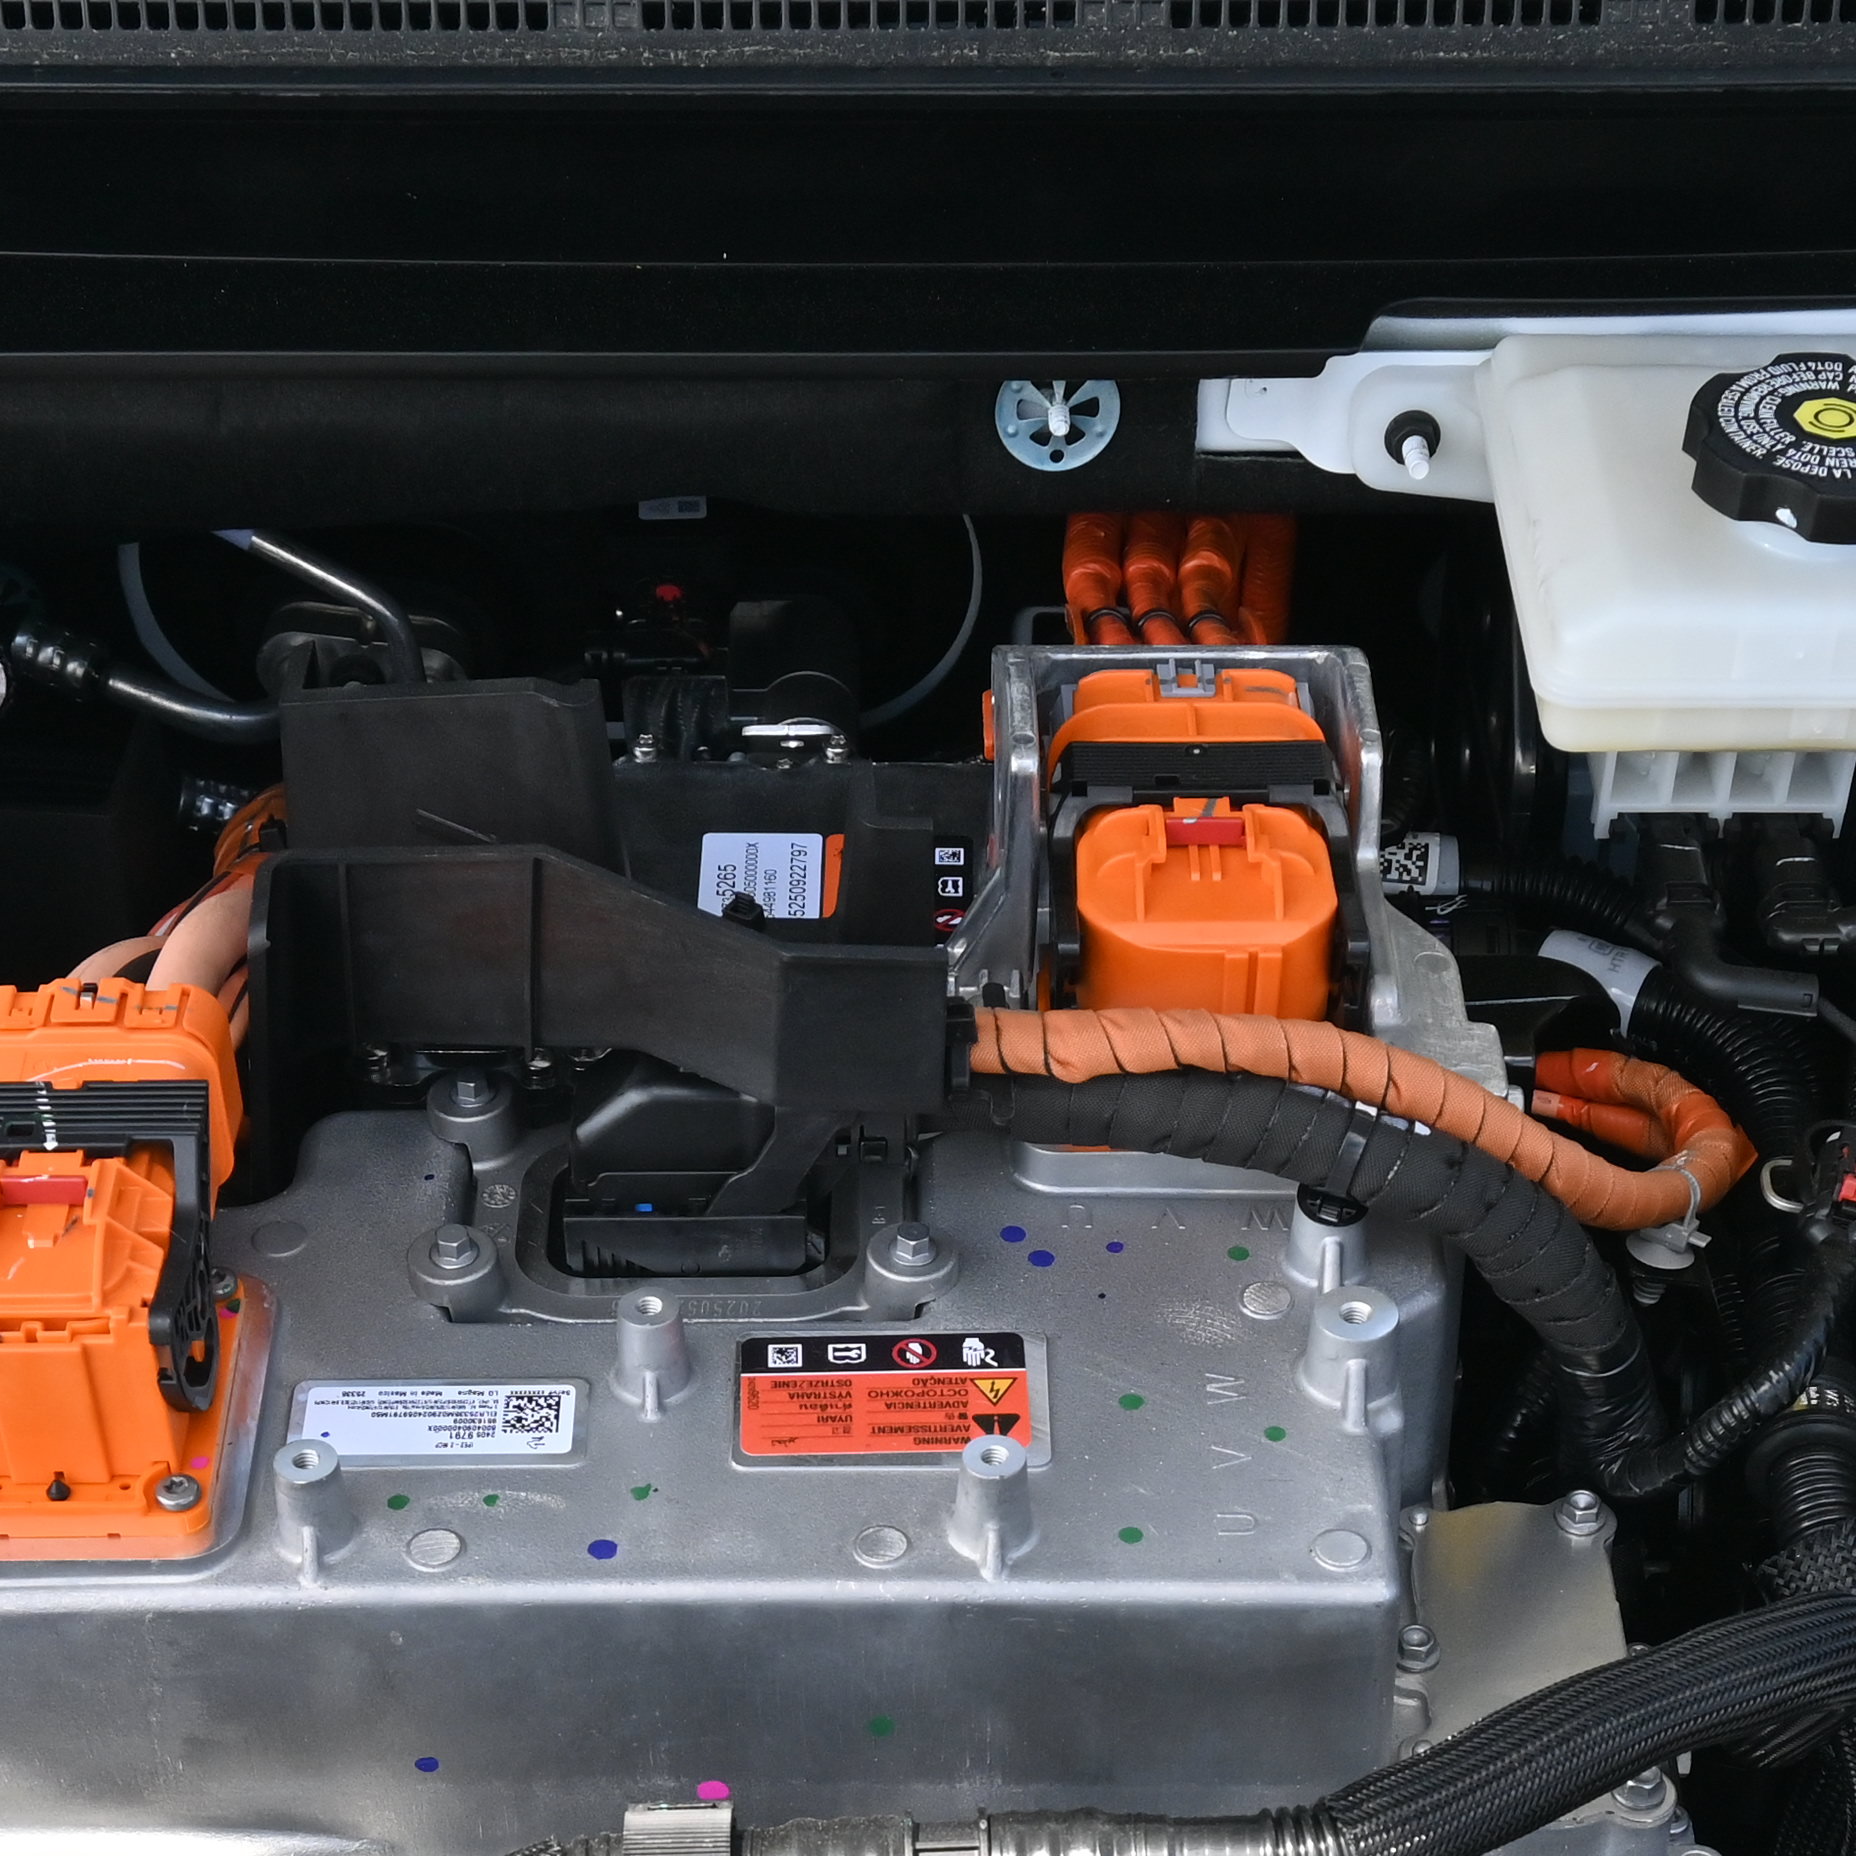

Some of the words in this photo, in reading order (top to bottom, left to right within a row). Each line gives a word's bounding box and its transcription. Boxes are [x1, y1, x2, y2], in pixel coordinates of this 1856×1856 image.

[1766, 362, 1808, 376] FLUID
[1807, 361, 1844, 371] DOT4
[1818, 371, 1844, 382] CAP
[1774, 380, 1841, 397] WARNING:
[1834, 468, 1853, 480] LA
[912, 1376, 969, 1388] ATENÇÃO
[867, 1388, 969, 1399] ОСТОРОЖНО
[884, 1400, 969, 1411] ADVERTENCIA
[817, 1414, 853, 1424] UYARI
[869, 1423, 971, 1434] AVERTISSEMENT
[913, 1435, 971, 1446] WARNING
[1210, 1444, 1253, 1470] V
[1216, 1512, 1257, 1536] U
